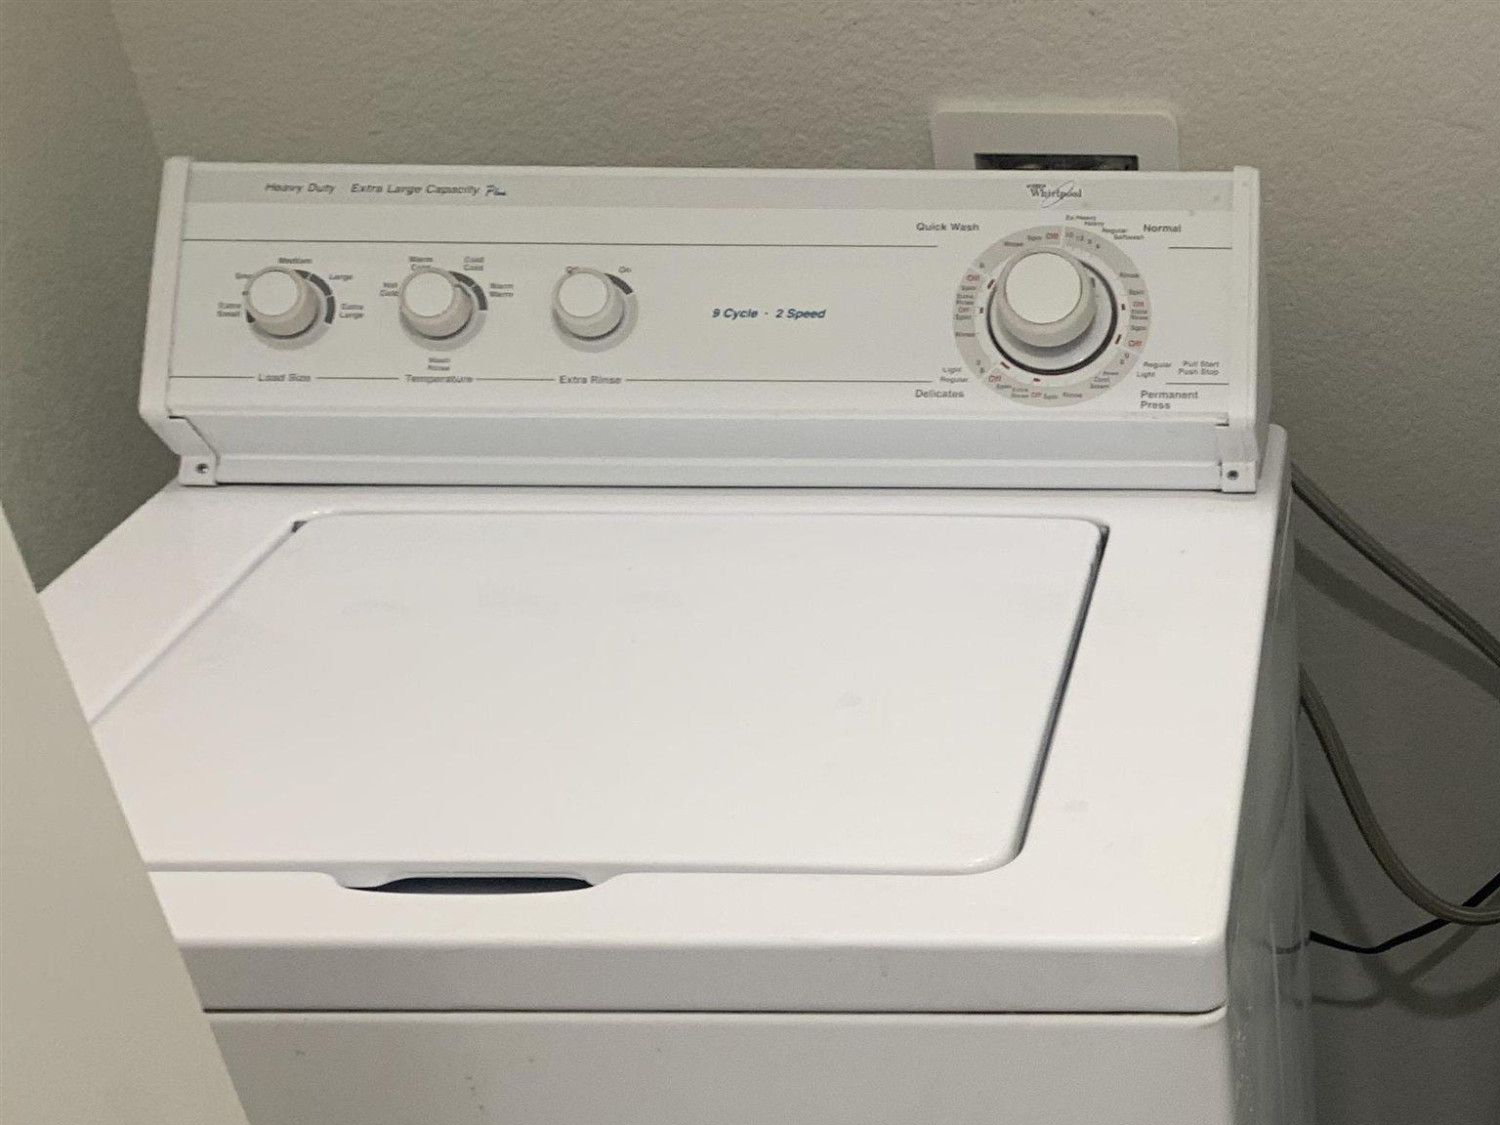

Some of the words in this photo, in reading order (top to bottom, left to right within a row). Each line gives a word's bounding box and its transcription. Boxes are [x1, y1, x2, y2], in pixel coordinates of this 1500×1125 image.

[264, 183, 302, 194] Heavy
[307, 183, 336, 193] Duty
[350, 184, 383, 194] Extra
[386, 185, 423, 196] Large
[916, 222, 947, 231] Quick
[950, 222, 980, 231] Wash
[1143, 223, 1182, 233] Normal
[712, 308, 720, 318] 9
[723, 307, 758, 320] Cycle
[776, 308, 784, 318] 2
[787, 308, 827, 320] Speed
[405, 374, 474, 383] Temperature
[560, 375, 588, 384] Extra
[590, 376, 622, 384] Rinse
[916, 389, 964, 399] Delicates
[1140, 390, 1199, 400] Permanent
[1140, 400, 1171, 410] Press
